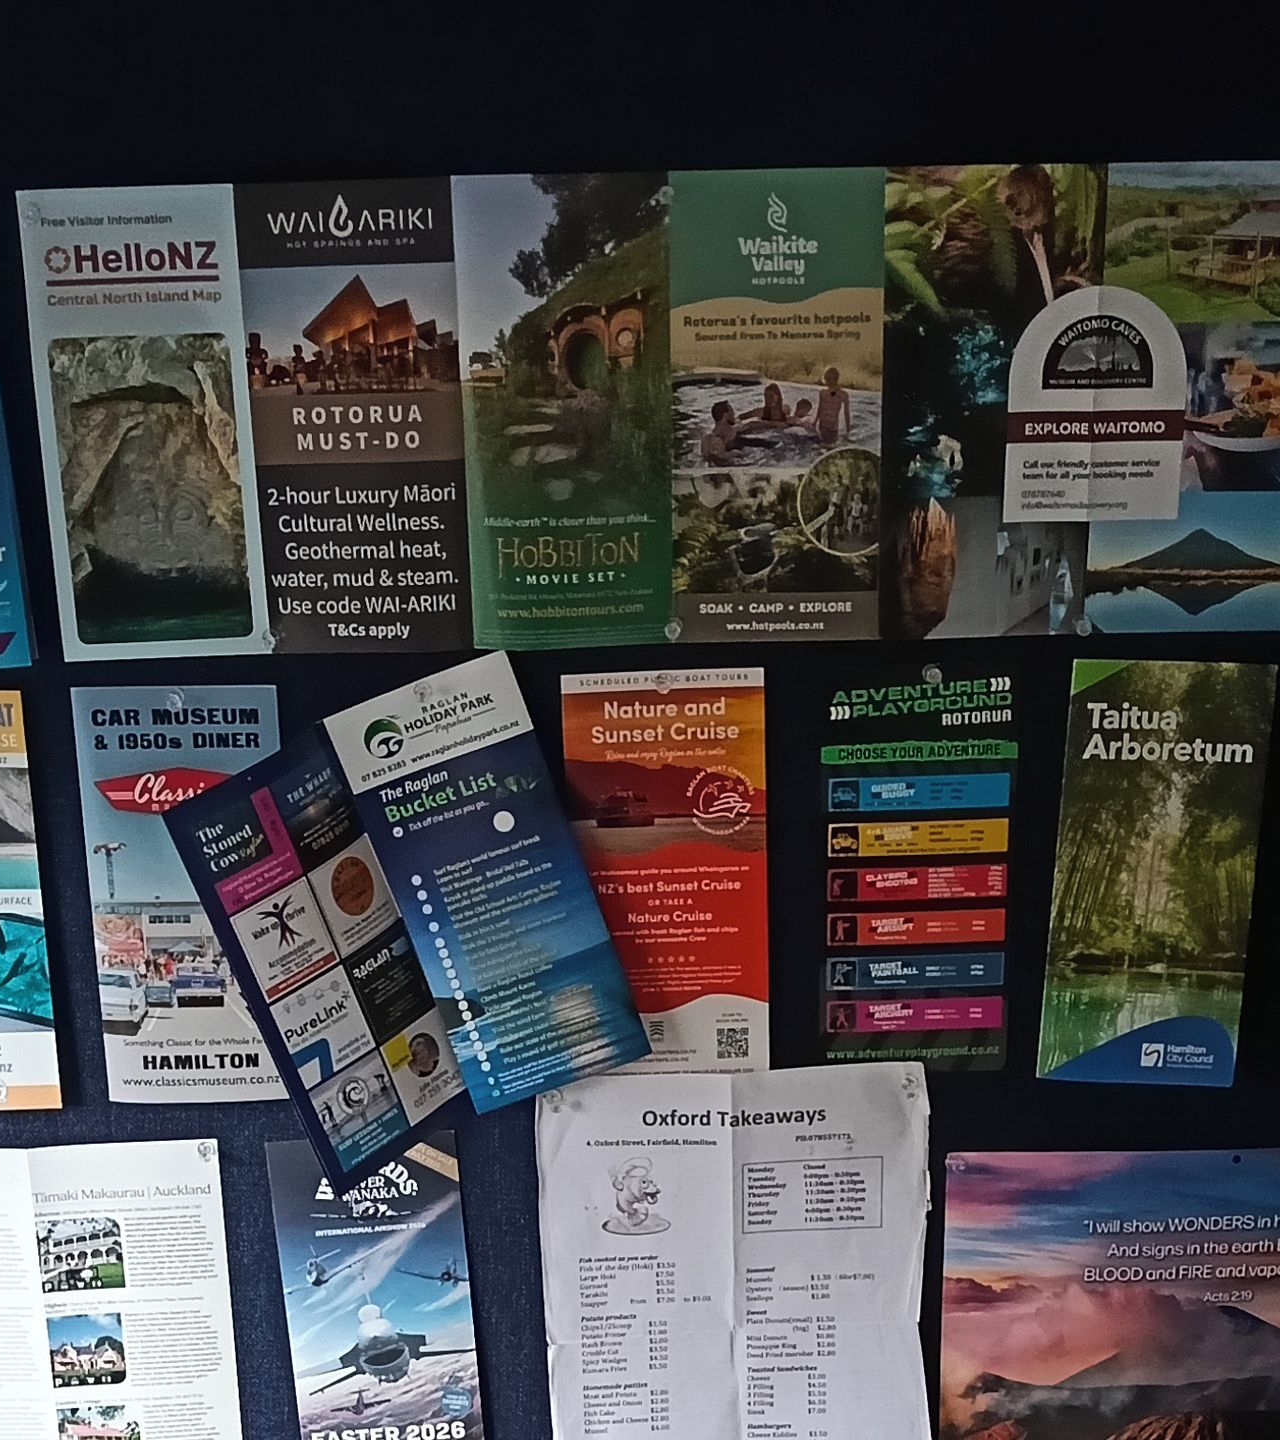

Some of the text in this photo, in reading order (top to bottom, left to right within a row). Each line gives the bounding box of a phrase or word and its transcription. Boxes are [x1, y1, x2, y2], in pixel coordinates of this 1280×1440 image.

[41, 213, 172, 227] Free Visitor Information
[738, 237, 818, 255] Waikite
[75, 241, 218, 273] HelloNZ
[752, 256, 805, 275] Valley
[47, 289, 222, 307] Central North Island Map
[683, 312, 871, 327] Rotorua's favourite hotpools
[292, 405, 422, 425] ROTORUA
[1025, 419, 1165, 436] EXPLORE WAITOMO
[297, 431, 420, 450] MUST-DO
[268, 484, 455, 508] 2-hour Luxury Māori
[526, 572, 615, 584] MOVIE SET
[699, 601, 852, 614] SOAK CAMP EXPLORE
[91, 709, 259, 726] CAR MUSEUM
[404, 693, 494, 733] HOLIDAY PARK
[603, 697, 726, 720] Nature and
[942, 709, 1012, 725] ROTORUA
[1087, 703, 1178, 730] Taitua
[95, 733, 260, 750] & 1950s DINER
[591, 723, 739, 744] Sunset Cruise
[838, 743, 1001, 761] CHOOSE YOUR ADVENTURE
[1083, 734, 1254, 763] Arboretum
[379, 771, 448, 803] The Raglan
[384, 772, 497, 823] Bucket List
[597, 879, 741, 894] NZ's best Sunset Cruise
[284, 998, 346, 1043] PureLink
[142, 1053, 259, 1070] HAMILTON
[123, 1075, 280, 1088] www.classicsmuseum.co.nz
[642, 1108, 826, 1128] Oxford Takeaways
[153, 1183, 212, 1198] Auckland
[1095, 1218, 1120, 1234] will
[1123, 1217, 1165, 1232] show
[1168, 1215, 1254, 1232] WONDERS
[1258, 1215, 1270, 1228] in
[1107, 1243, 1138, 1257] And
[1142, 1242, 1183, 1259] signs
[1187, 1242, 1200, 1255] in
[1204, 1240, 1228, 1254] the
[1232, 1238, 1273, 1253] earth
[1084, 1266, 1143, 1282] BLOOD
[1146, 1265, 1175, 1280] and
[1179, 1264, 1212, 1279] FIRE
[1216, 1263, 1245, 1278] and
[1204, 1290, 1229, 1302] Acts
[406, 1422, 466, 1440] 2026
